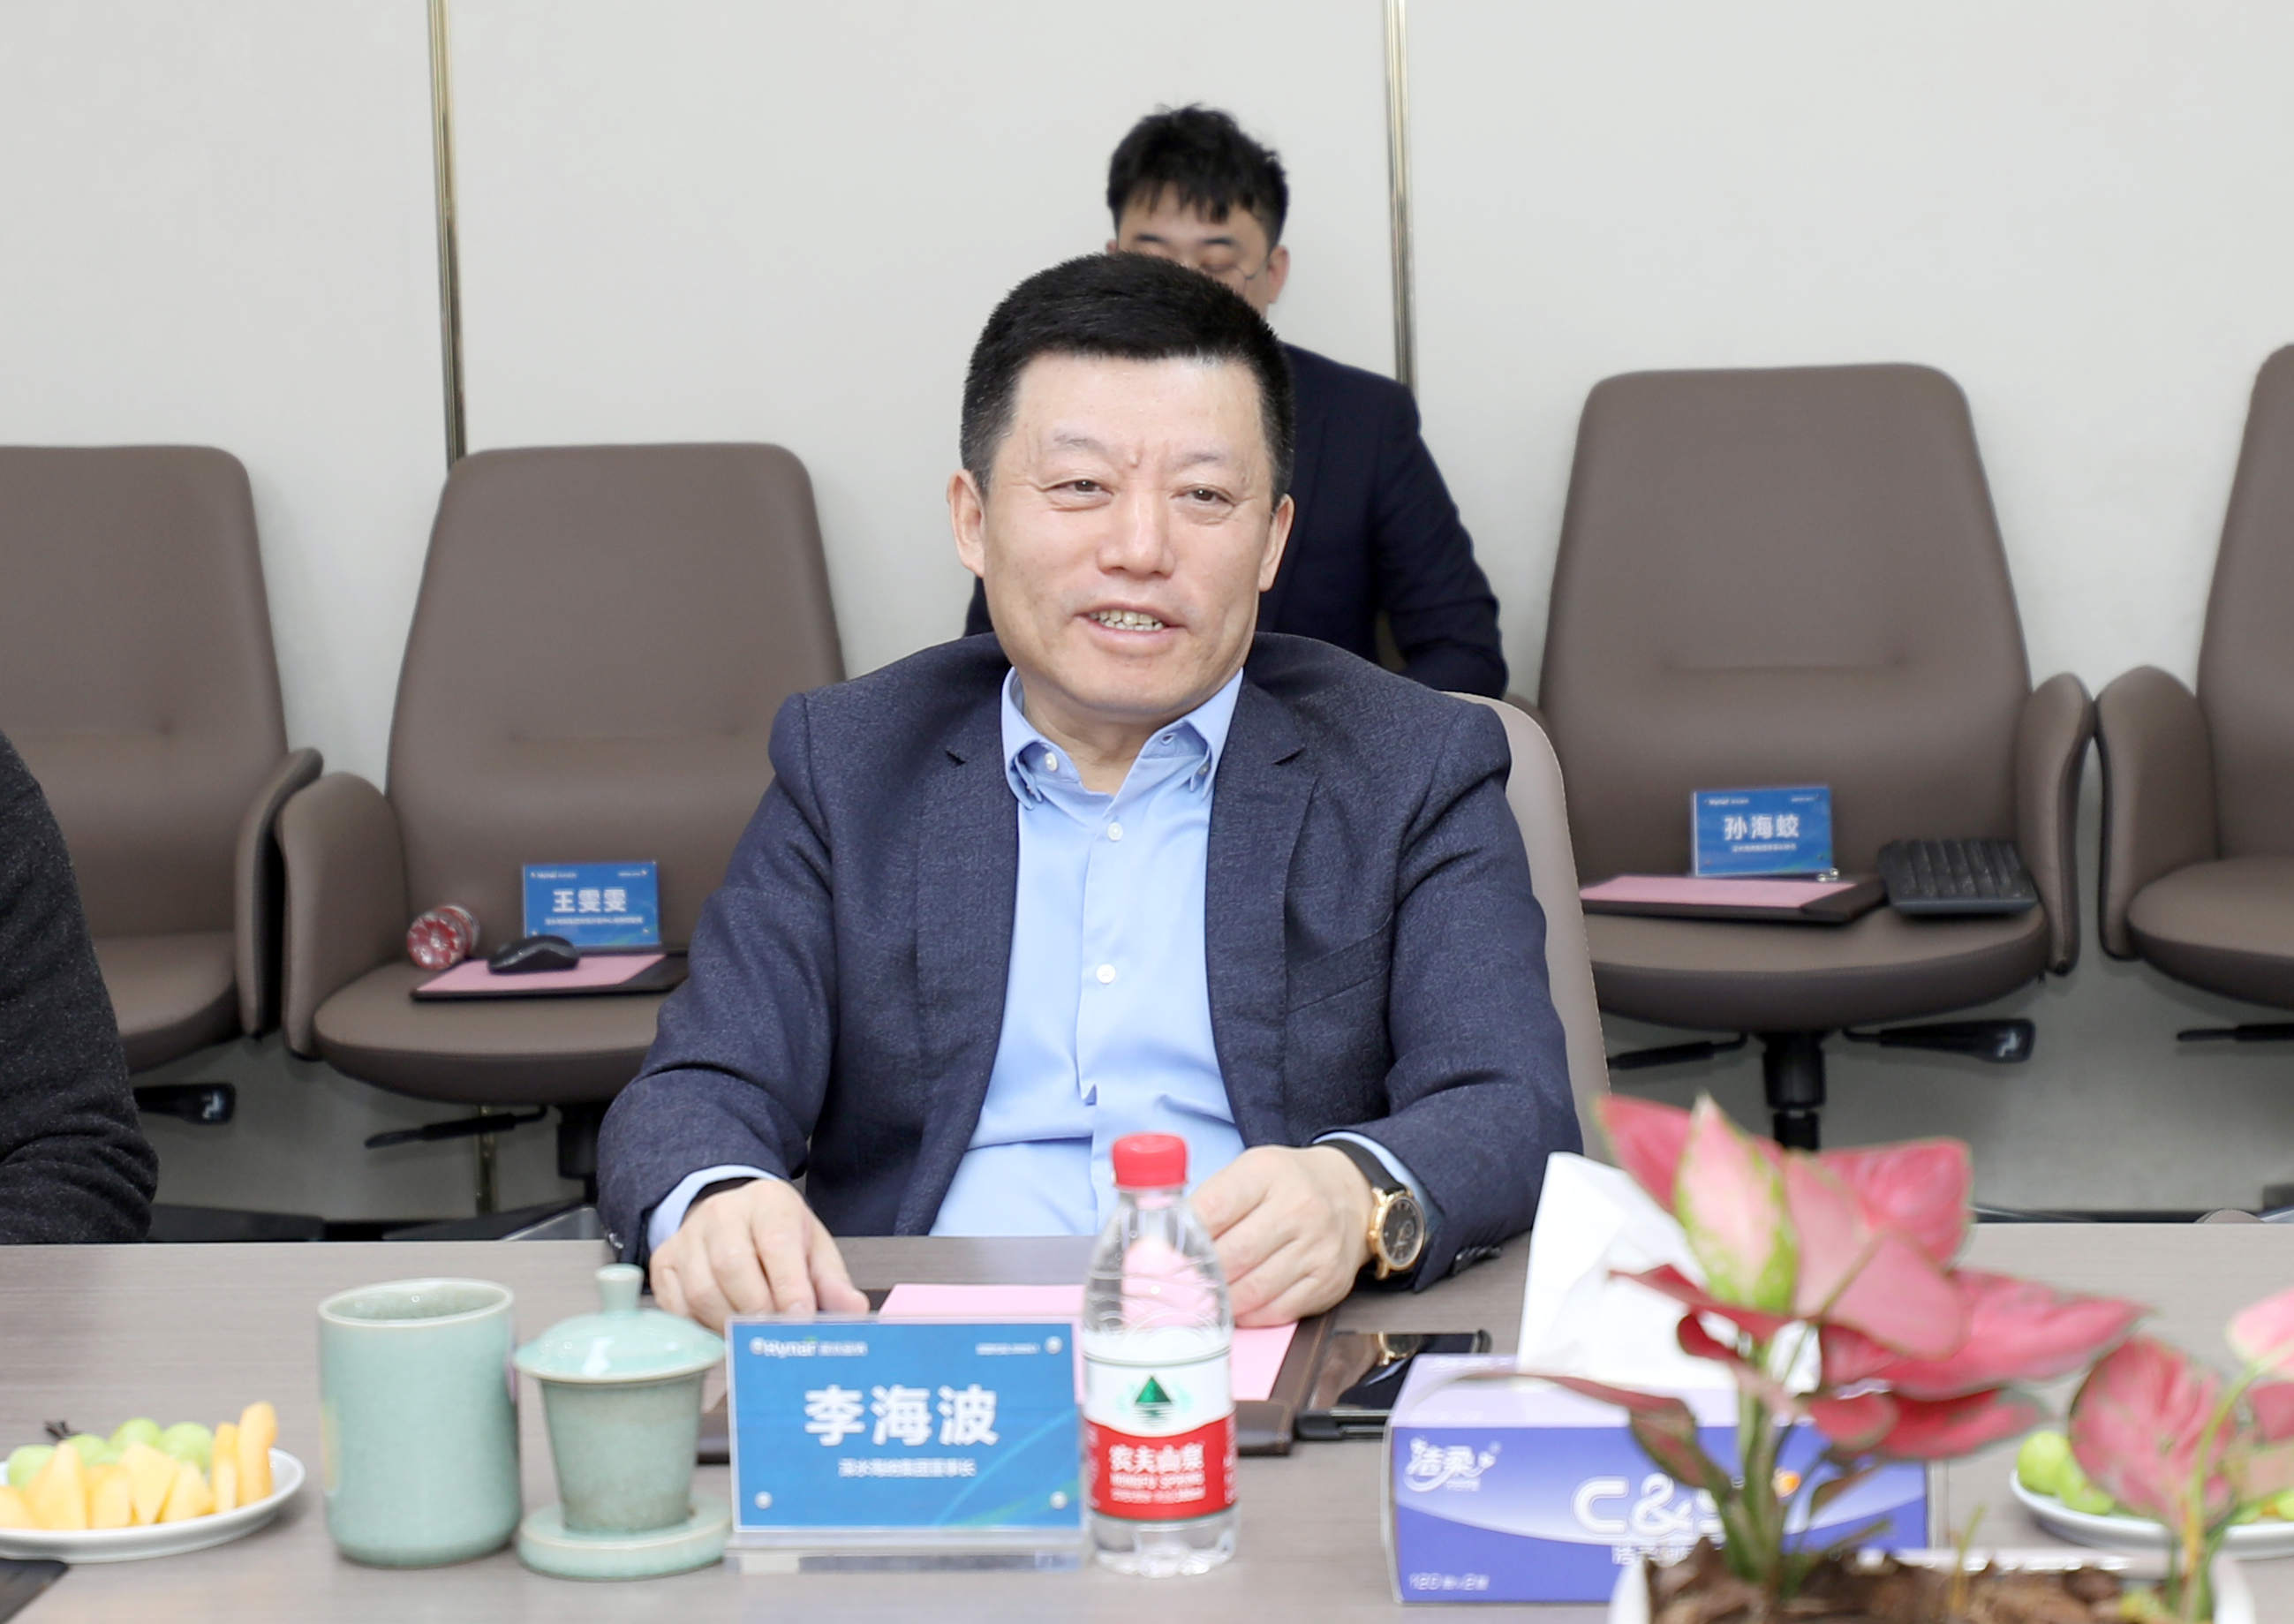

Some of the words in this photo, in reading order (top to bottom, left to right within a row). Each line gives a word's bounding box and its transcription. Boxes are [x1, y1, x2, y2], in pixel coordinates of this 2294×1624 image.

[804, 1384, 999, 1446] 李海波
[1109, 1442, 1205, 1473] 农夫山泉
